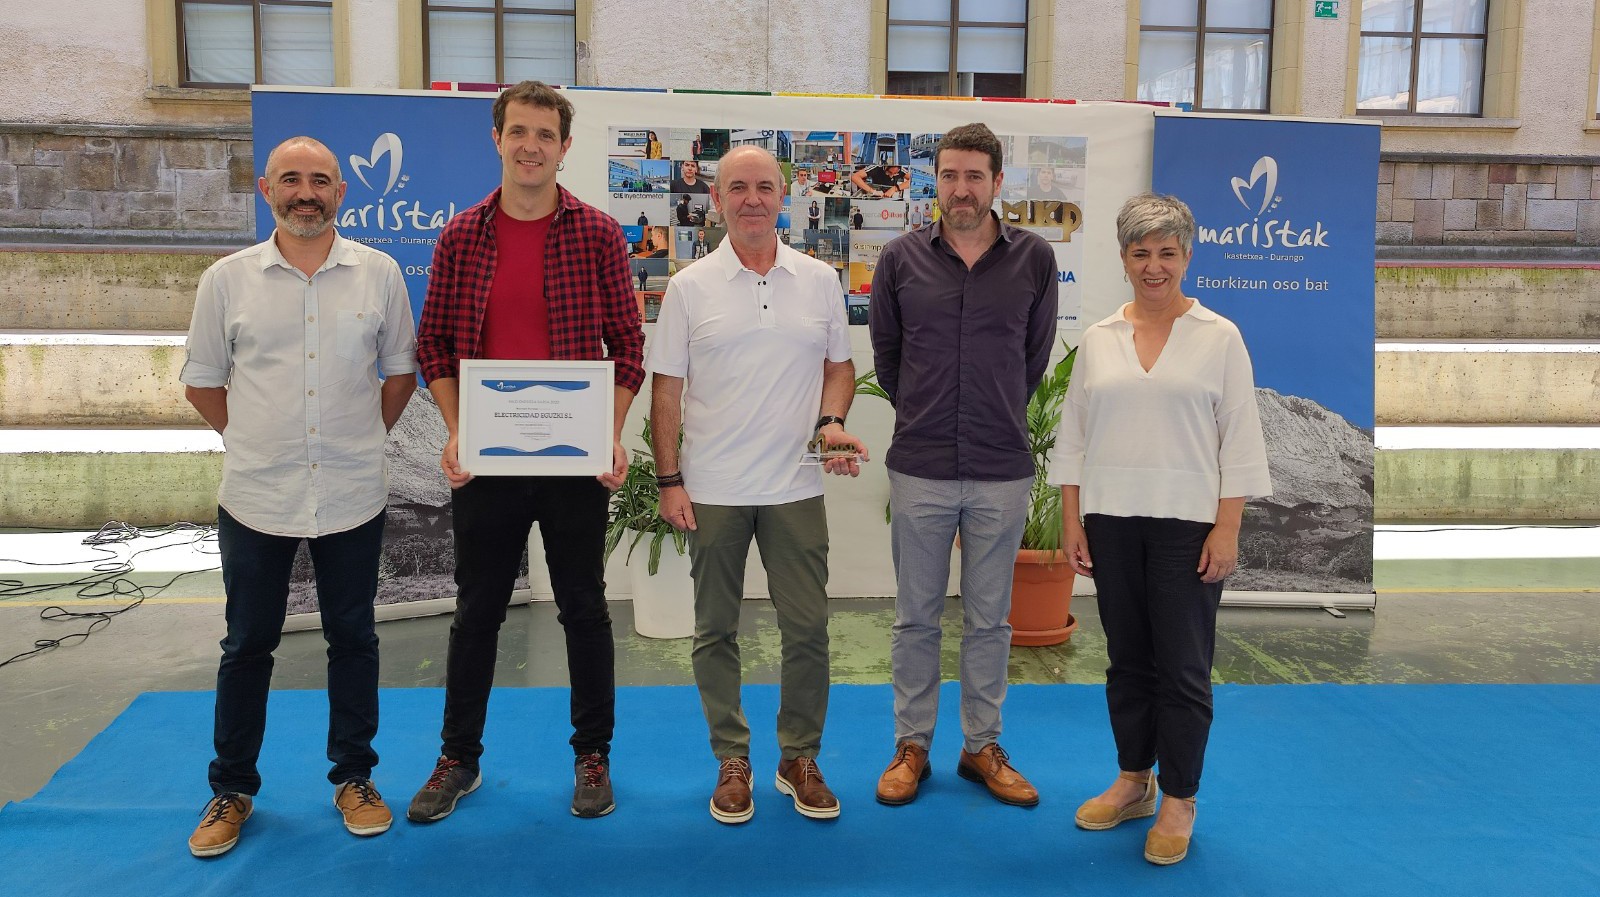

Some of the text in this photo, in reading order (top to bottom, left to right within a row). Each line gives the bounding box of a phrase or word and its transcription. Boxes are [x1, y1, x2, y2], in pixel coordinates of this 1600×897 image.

[334, 198, 456, 231] arista
[1198, 217, 1330, 248] maristak
[400, 236, 438, 246] Durango
[1224, 252, 1263, 260] Ikastetxea
[1270, 253, 1304, 263] Durango
[1196, 276, 1329, 291] Etorkizun oso bat
